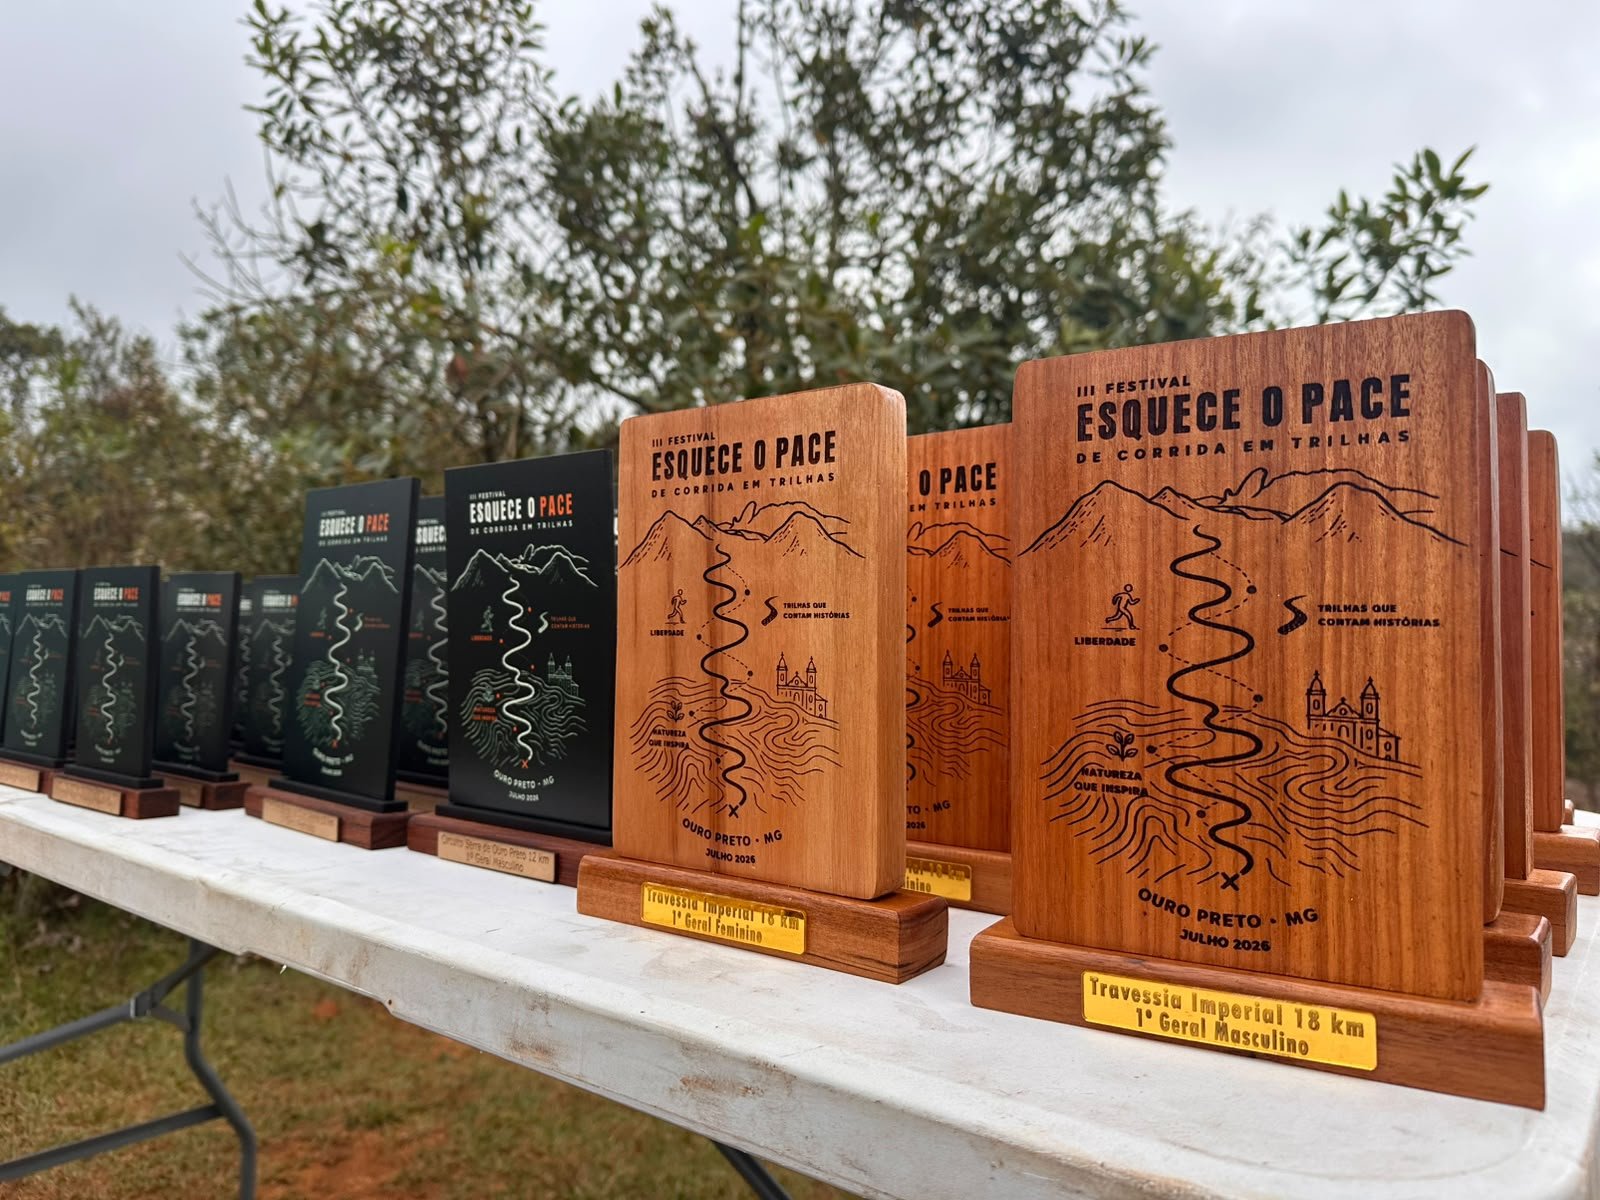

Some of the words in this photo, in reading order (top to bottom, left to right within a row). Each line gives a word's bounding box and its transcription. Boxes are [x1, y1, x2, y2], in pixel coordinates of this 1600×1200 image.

[1077, 385, 1095, 397] III
[1106, 376, 1190, 393] FESTIVAL
[1077, 389, 1241, 442] ESQUECE
[1262, 386, 1283, 427] O
[1302, 375, 1411, 425] PACE
[652, 438, 663, 447] III
[668, 431, 715, 445] FESTIVAL
[1077, 451, 1102, 464] DE
[1117, 443, 1225, 461] CORRIDA
[1244, 440, 1274, 452] EM
[1292, 430, 1410, 449] TRILHAS
[652, 442, 742, 481] ESQUECE
[754, 439, 766, 470] O
[776, 430, 836, 467] PACE
[652, 488, 666, 498] DE
[674, 482, 734, 496] CORRIDA
[743, 480, 761, 490] EM
[770, 473, 835, 487] TRILHAS
[919, 470, 930, 496] O
[940, 463, 996, 494] PACE
[470, 498, 522, 523] ESQUECE
[528, 497, 535, 518] O
[540, 493, 573, 517] PACE
[910, 504, 925, 512] EM
[935, 498, 996, 510] TRILHAS
[320, 516, 355, 536] ESQUECE
[366, 513, 389, 532] PACE
[484, 525, 518, 534] CORRIDA
[537, 520, 573, 528] TRILHAS
[814, 611, 850, 619] HISTÓRIAS
[1318, 604, 1368, 613] TRILHAS
[1372, 604, 1397, 614] QUE
[1318, 617, 1371, 627] CONTAM
[1373, 616, 1440, 627] HISTÓRIAS
[1074, 637, 1136, 647] LIBERDADE
[652, 728, 686, 737] NATUREZA
[649, 739, 662, 747] QUE
[664, 740, 690, 749] INSPIRA
[494, 769, 512, 785] OURO
[514, 779, 535, 789] PRETO
[543, 776, 554, 786] MG
[1081, 768, 1142, 780] NATUREZA
[1074, 782, 1097, 791] QUE
[1102, 784, 1148, 797] INSPIRA
[933, 800, 950, 812] MG
[682, 818, 712, 841] OURO
[715, 832, 751, 847] PRETO
[764, 829, 783, 844] MG
[705, 848, 733, 862] JULHO
[735, 855, 756, 864] 2026
[647, 888, 698, 911] Travessia
[703, 898, 753, 921] Imperial
[762, 909, 774, 925] 18
[780, 910, 799, 930] km
[1138, 888, 1190, 919] OURO
[1197, 908, 1262, 929] PRETO
[1286, 908, 1318, 927] MG
[685, 914, 711, 932] Geral
[716, 920, 762, 943] Feminino
[1180, 929, 1229, 949] JULHO
[1233, 939, 1271, 952] 2026
[1090, 976, 1182, 1009] Travessia
[1192, 992, 1282, 1025] Imperial
[1294, 1008, 1320, 1031] 18
[1331, 1012, 1364, 1038] km
[1160, 1014, 1206, 1038] Geral
[1215, 1021, 1309, 1056] Masculino
